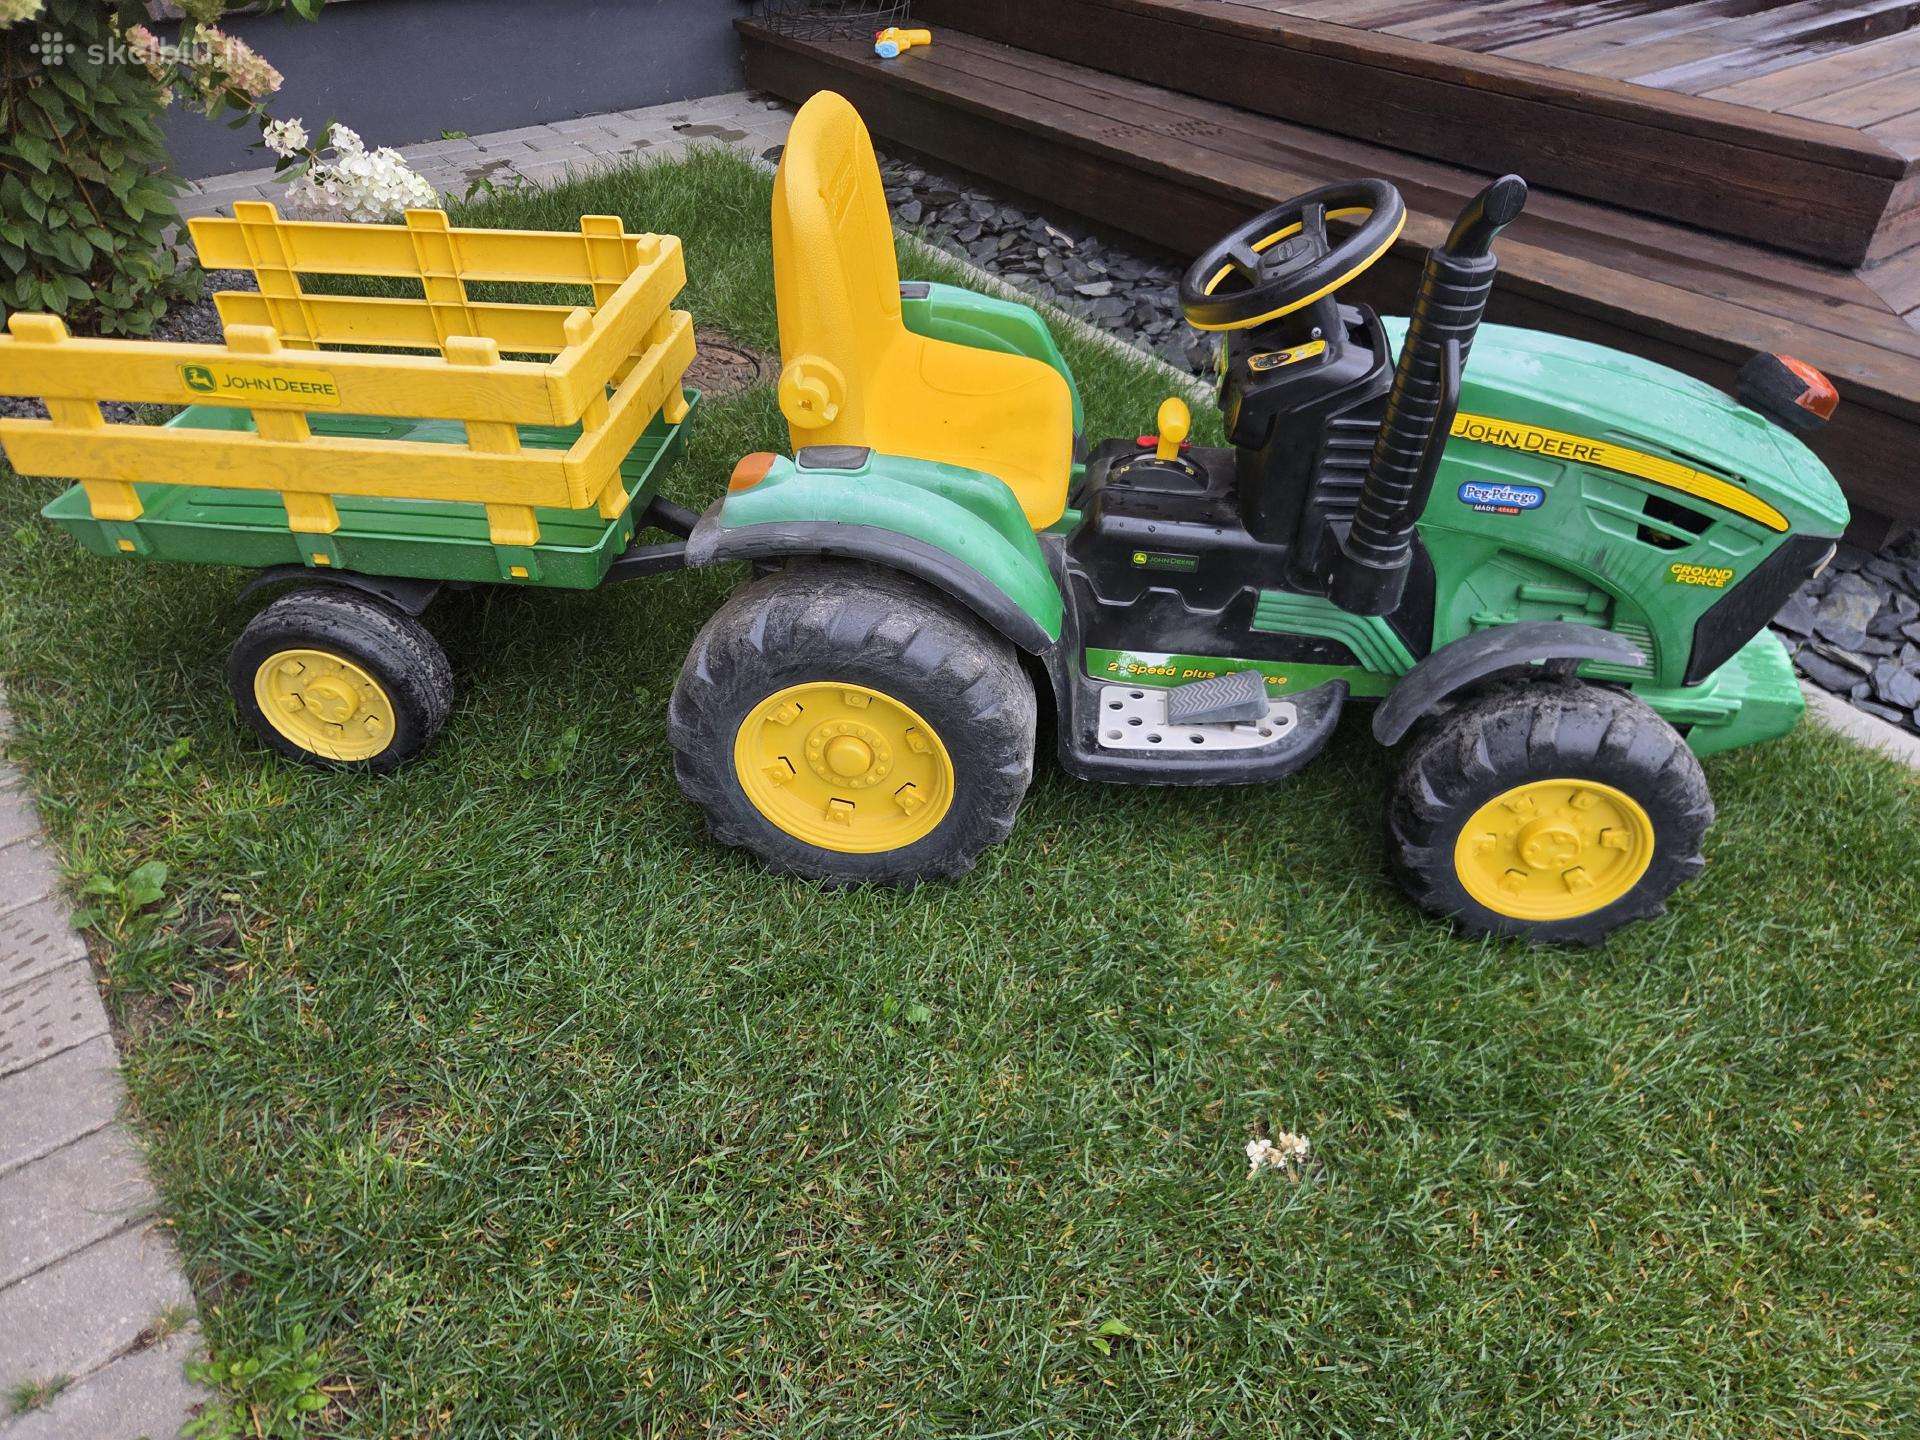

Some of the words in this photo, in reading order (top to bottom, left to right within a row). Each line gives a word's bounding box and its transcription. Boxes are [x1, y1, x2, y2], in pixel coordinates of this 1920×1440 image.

[222, 374, 271, 391] JOHN
[273, 377, 335, 396] DEERE
[1454, 419, 1520, 446] JOHN
[1523, 431, 1605, 462] DEERE
[1671, 563, 1733, 580] GROUND
[1675, 573, 1727, 588] FORCE
[1182, 669, 1216, 680] plus
